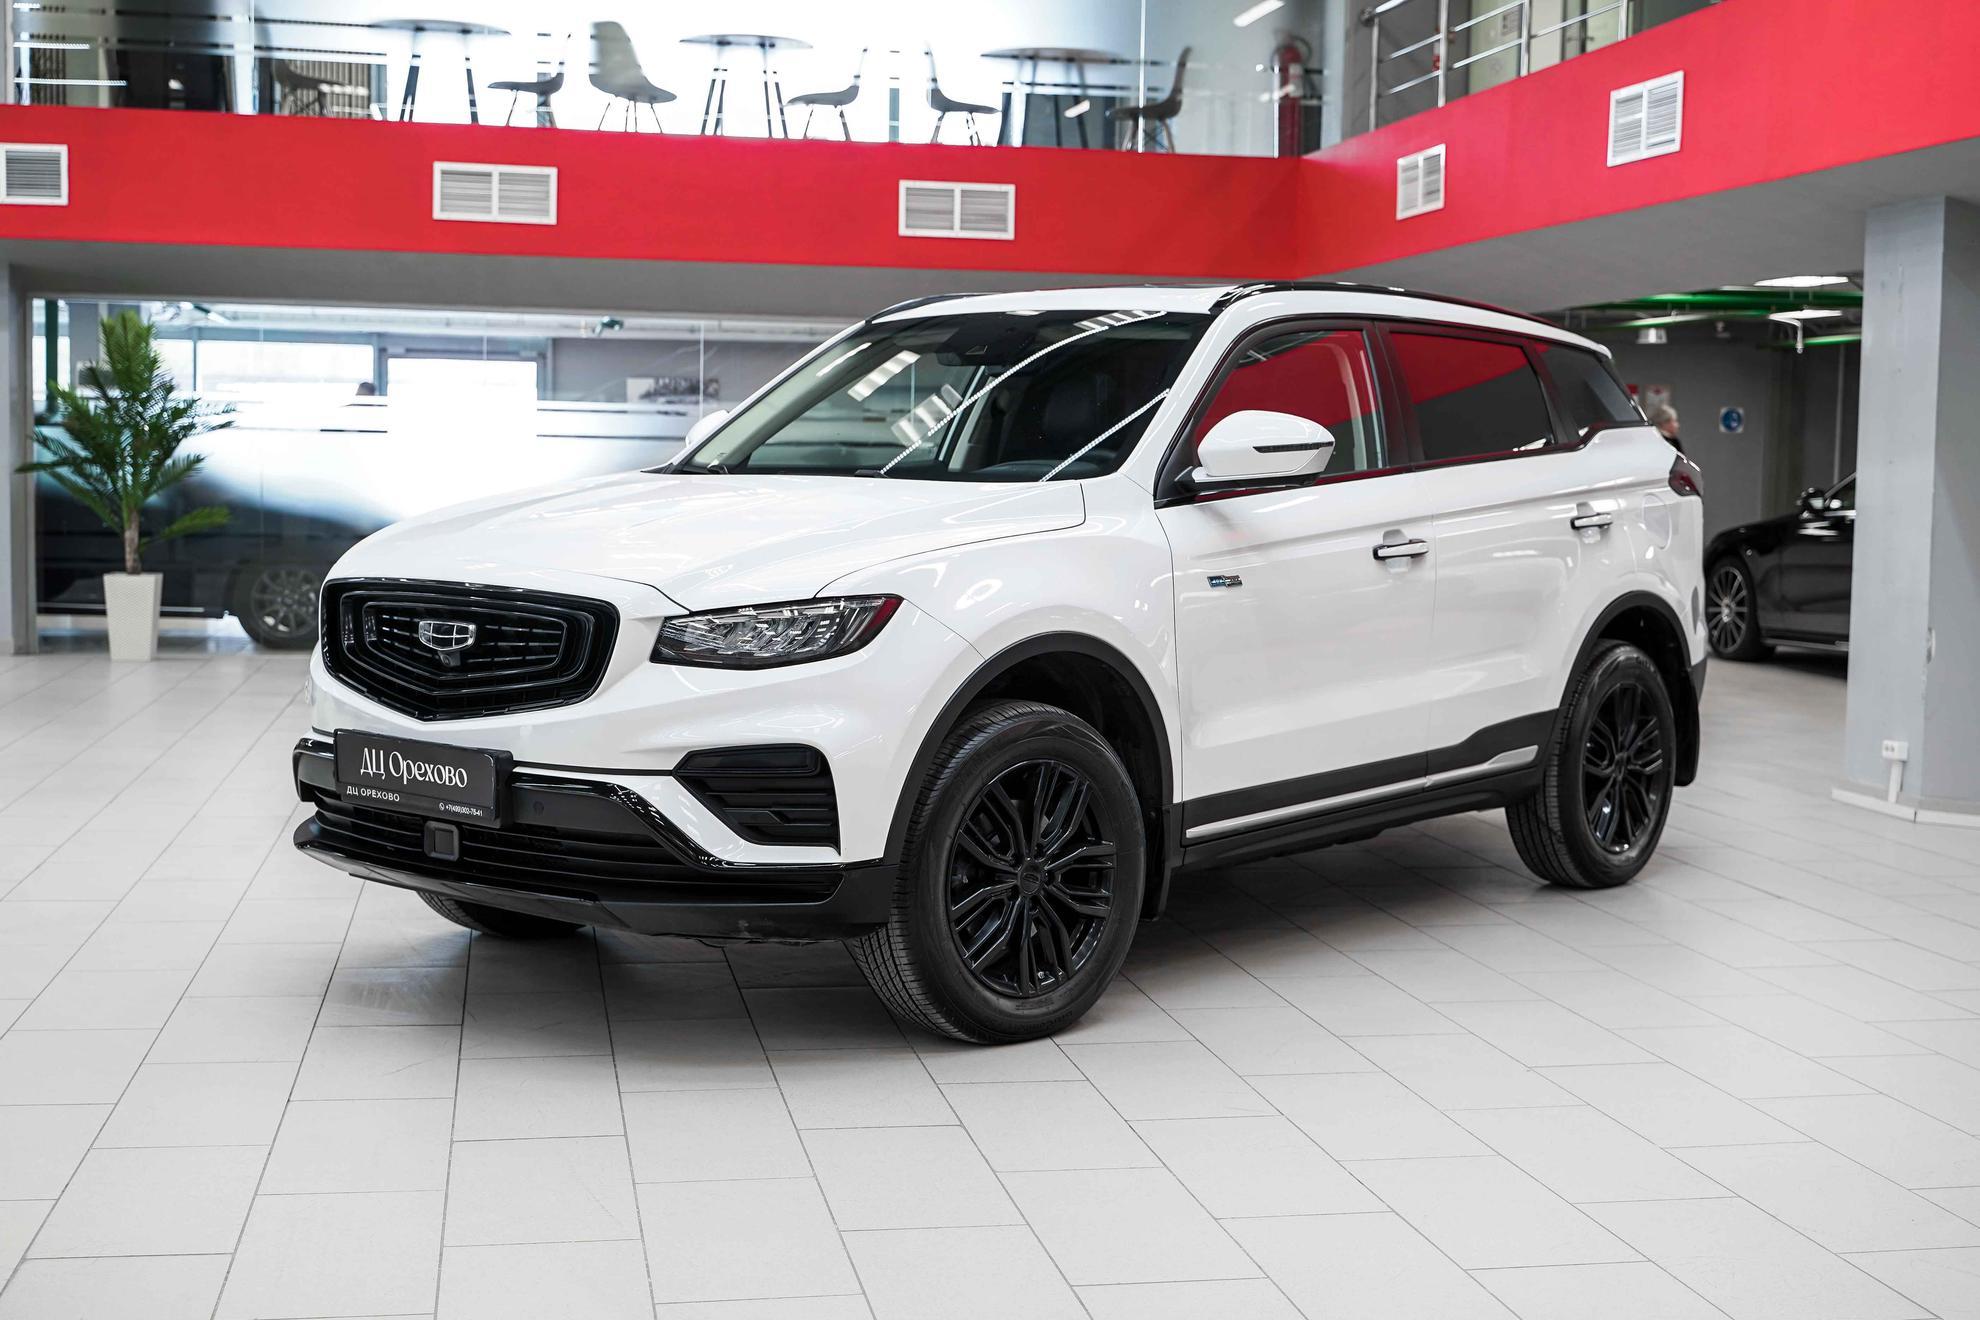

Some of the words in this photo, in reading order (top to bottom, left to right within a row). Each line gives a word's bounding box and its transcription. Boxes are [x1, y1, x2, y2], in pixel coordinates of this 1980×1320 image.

[360, 747, 386, 780] ДЦ
[389, 751, 468, 788] Орехово
[346, 785, 359, 797] ДЦ
[360, 788, 400, 802] ОРЕХОВО
